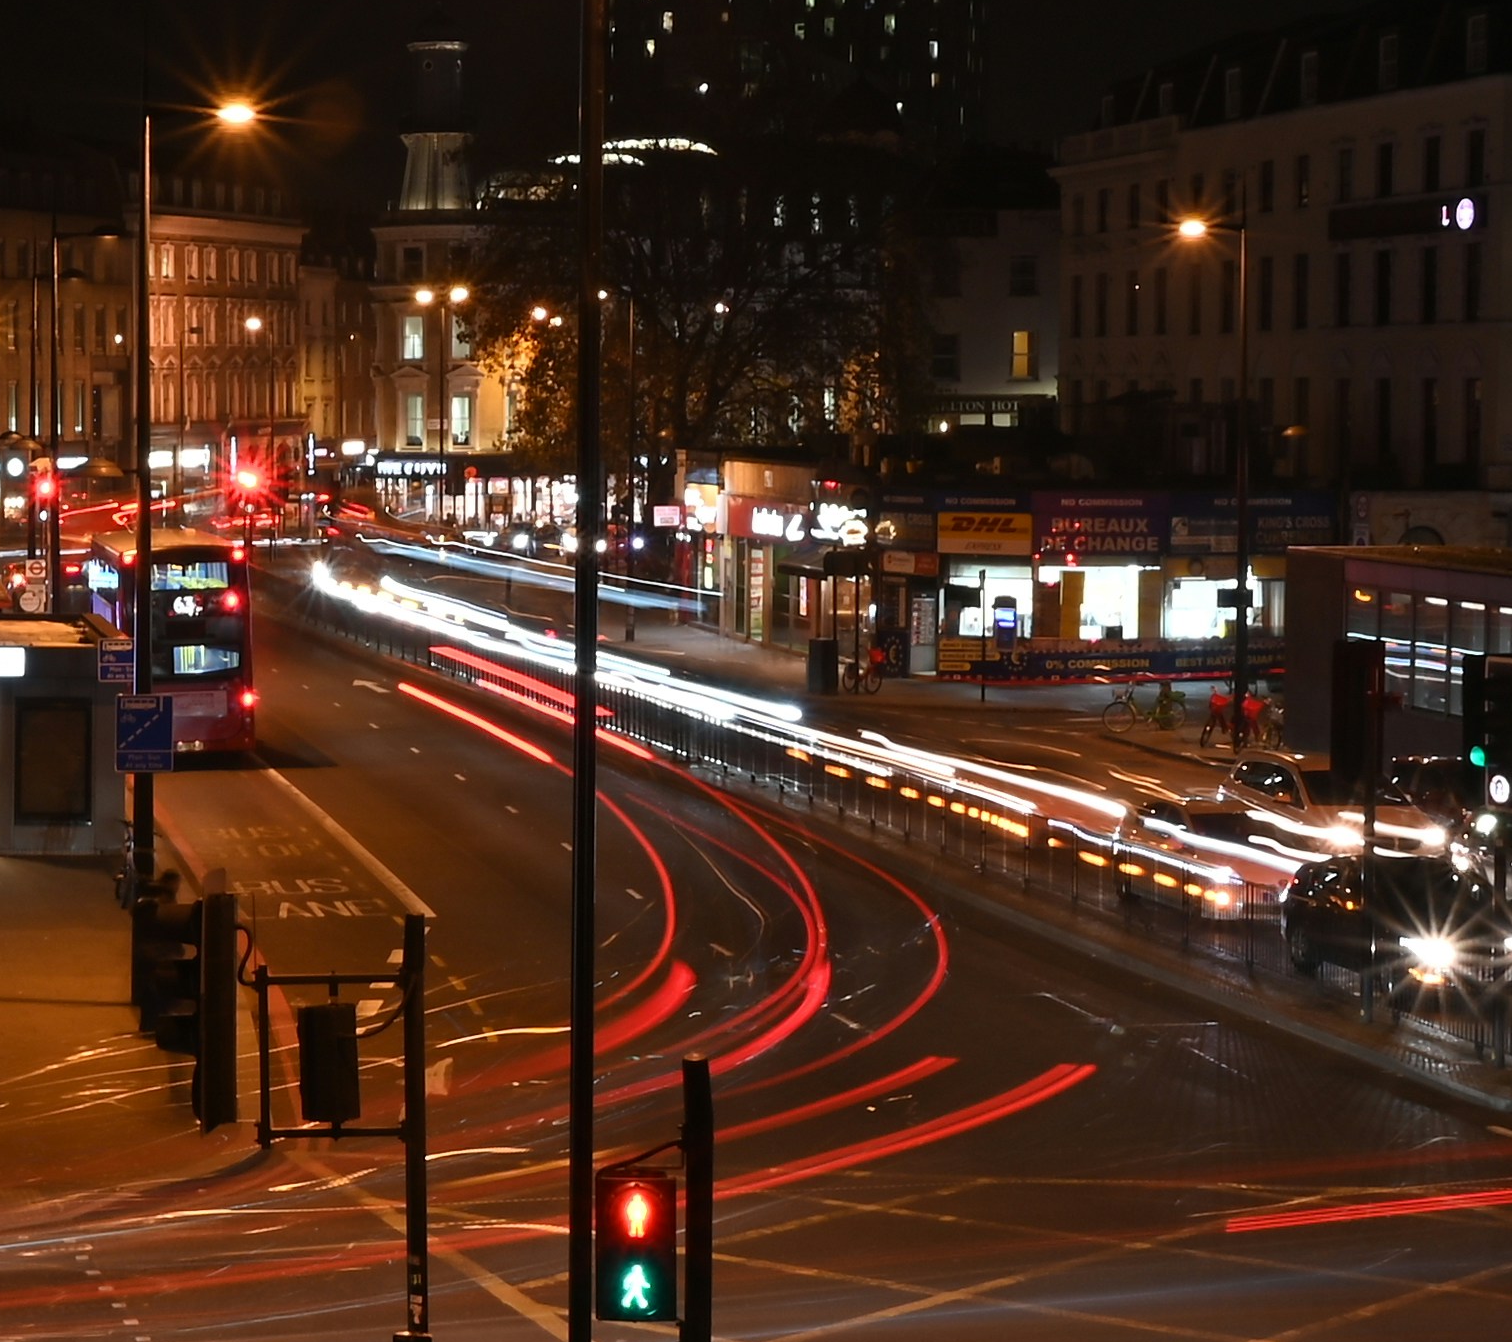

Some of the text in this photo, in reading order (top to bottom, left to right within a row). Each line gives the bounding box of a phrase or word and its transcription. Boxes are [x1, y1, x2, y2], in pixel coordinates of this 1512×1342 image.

[992, 400, 1021, 411] HOT
[960, 497, 1016, 506] COMMISSION
[1061, 498, 1143, 507] NO COMMISSION
[951, 516, 1017, 534] DHL
[1051, 517, 1149, 534] BUREAUX
[1295, 515, 1330, 529] CROSS
[1040, 535, 1160, 552] DE CHANGE
[1045, 659, 1150, 669] 0% COMMISSION
[1176, 658, 1202, 667] BEST
[231, 877, 350, 897] BUS
